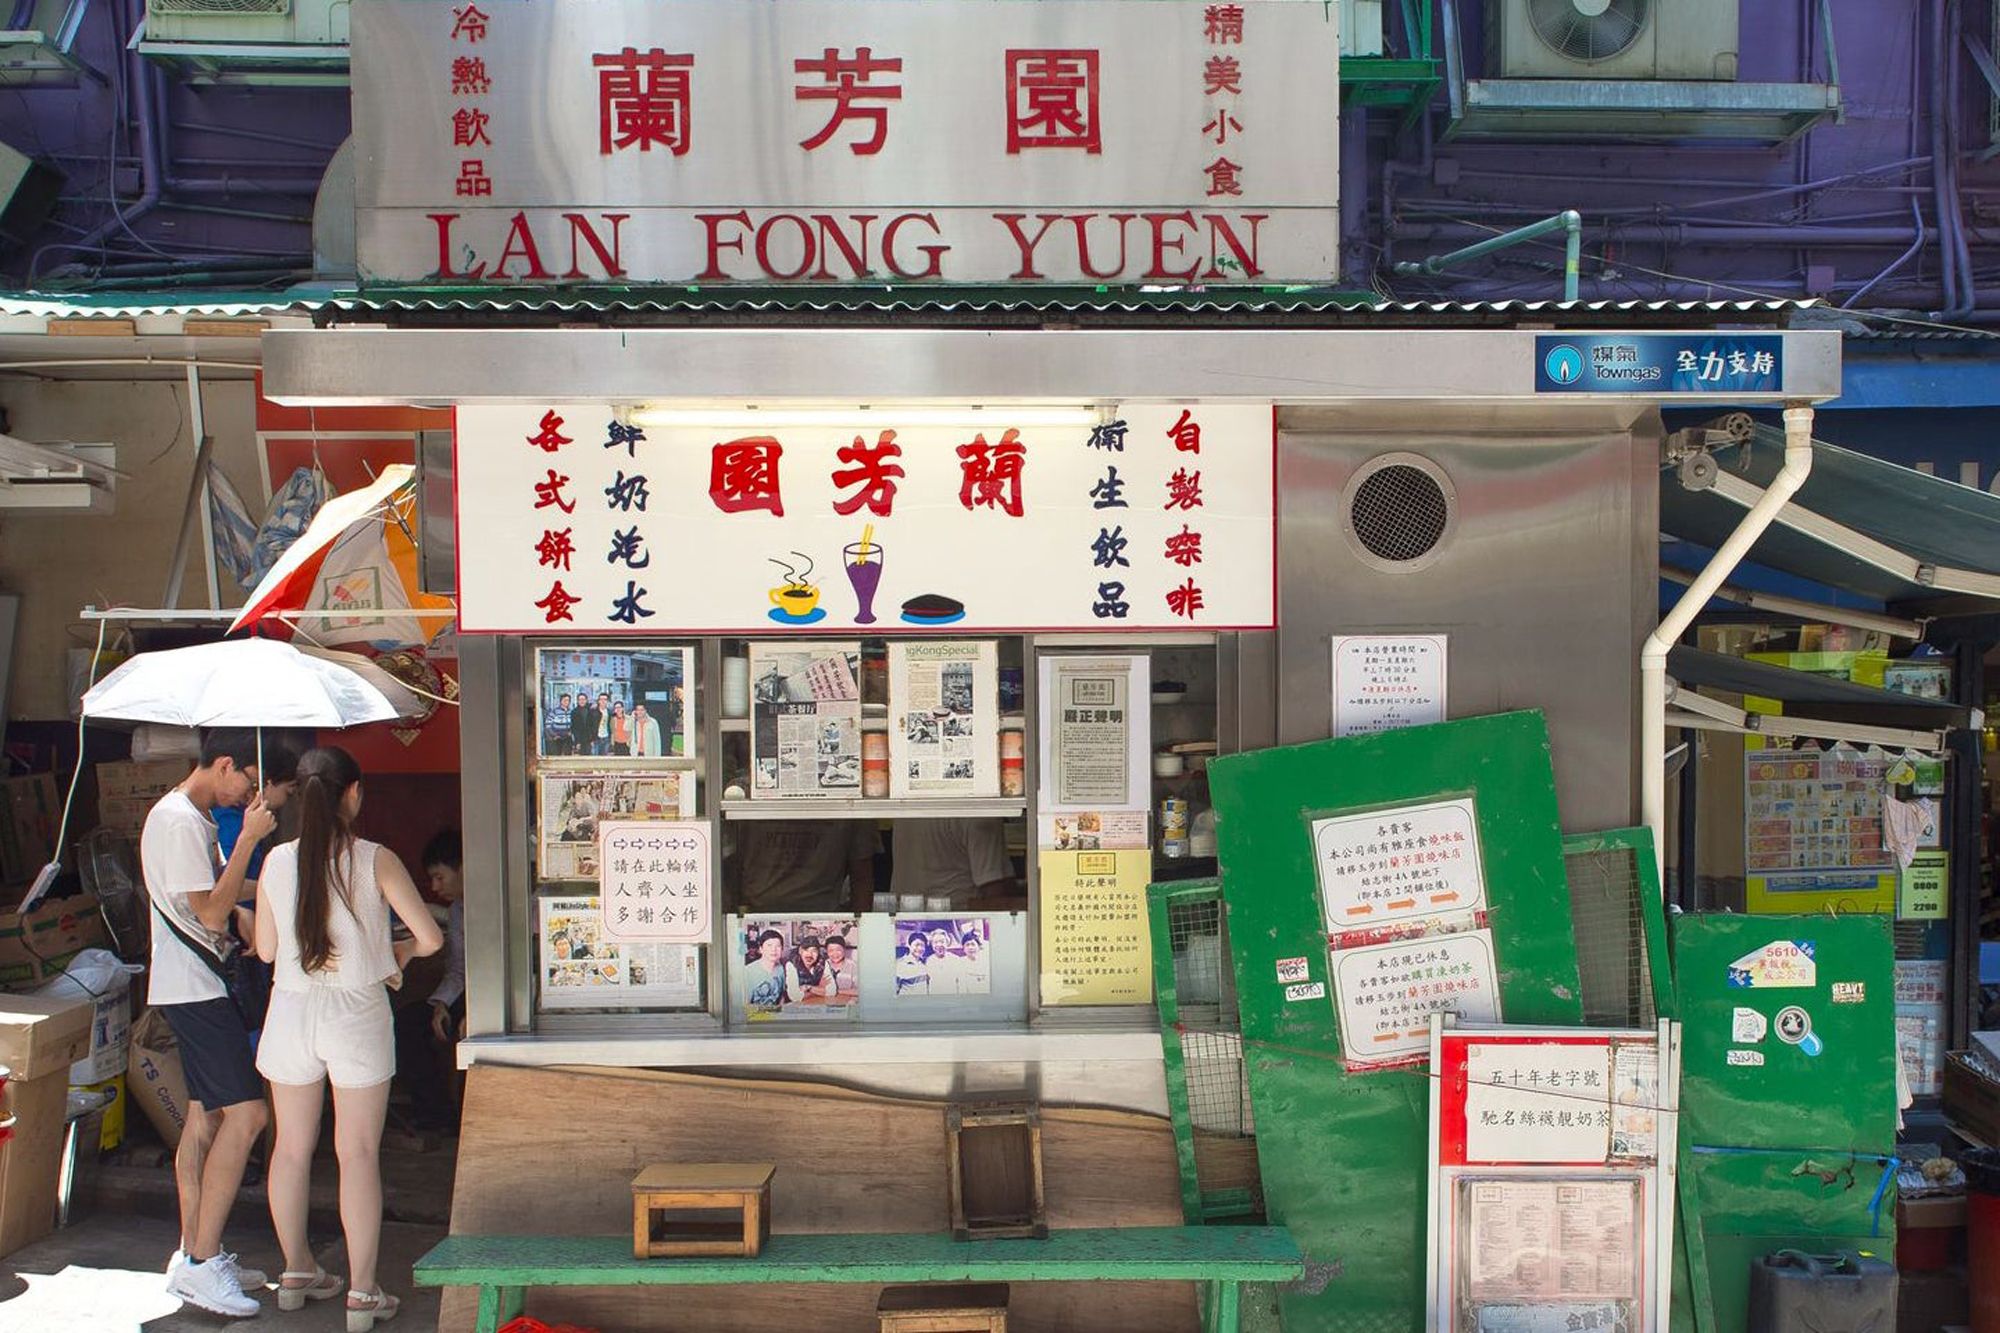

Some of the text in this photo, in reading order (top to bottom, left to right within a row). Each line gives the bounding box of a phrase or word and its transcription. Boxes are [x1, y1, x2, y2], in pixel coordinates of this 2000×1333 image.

[451, 2, 492, 196] 冷熱飲品
[592, 47, 1102, 156] 蘭芳園
[1202, 3, 1244, 197] 精美小食
[426, 210, 1269, 282] LAN FONG YUEN
[1593, 364, 1661, 382] Towngas
[1677, 350, 1775, 381] 全力支持
[526, 409, 581, 624] 各式餅食
[613, 859, 698, 874] 請在此輪候
[615, 881, 699, 899] 人齊入坐
[617, 906, 699, 924] 多謝合作
[1767, 948, 1798, 957] 5610
[1491, 1069, 1601, 1087] 五十年老字號
